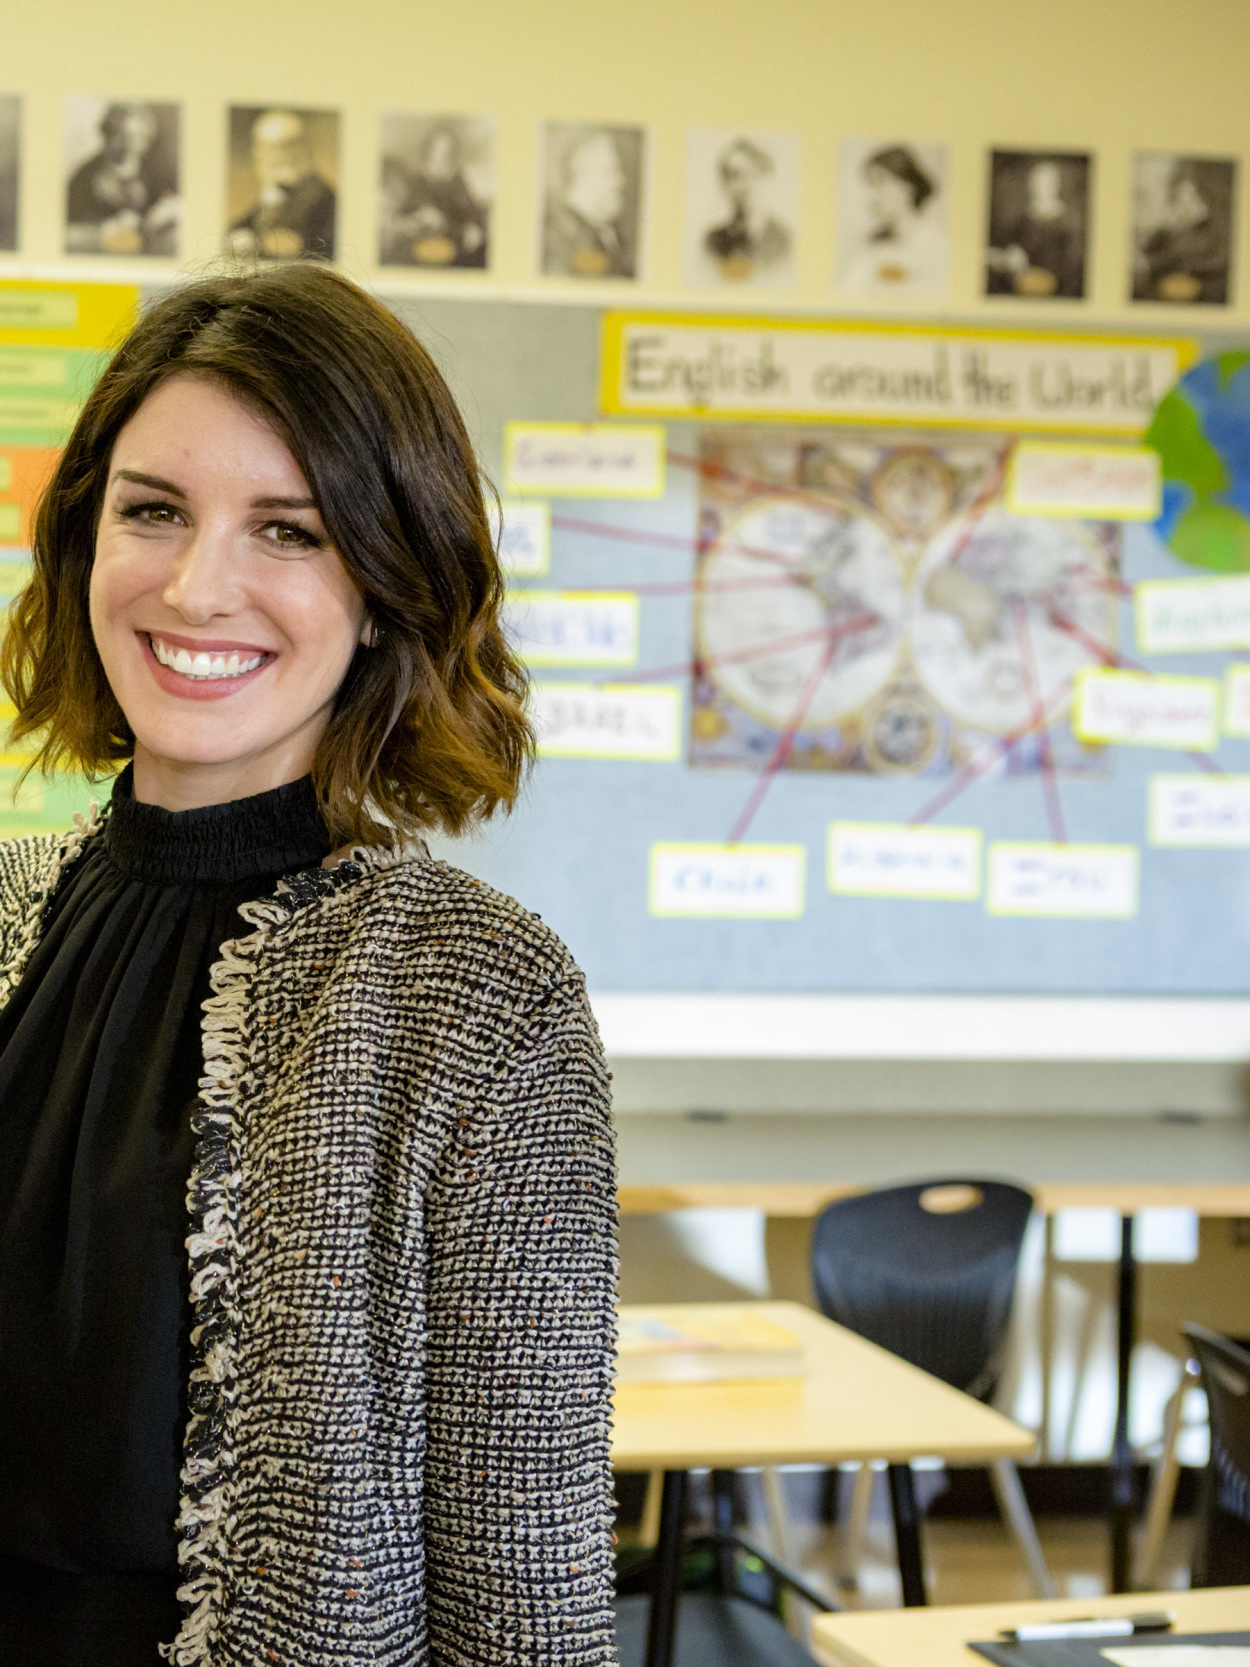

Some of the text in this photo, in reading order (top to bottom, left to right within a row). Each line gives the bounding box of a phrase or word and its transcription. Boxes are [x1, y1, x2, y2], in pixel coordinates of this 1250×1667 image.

[626, 336, 1157, 411] English around the World
